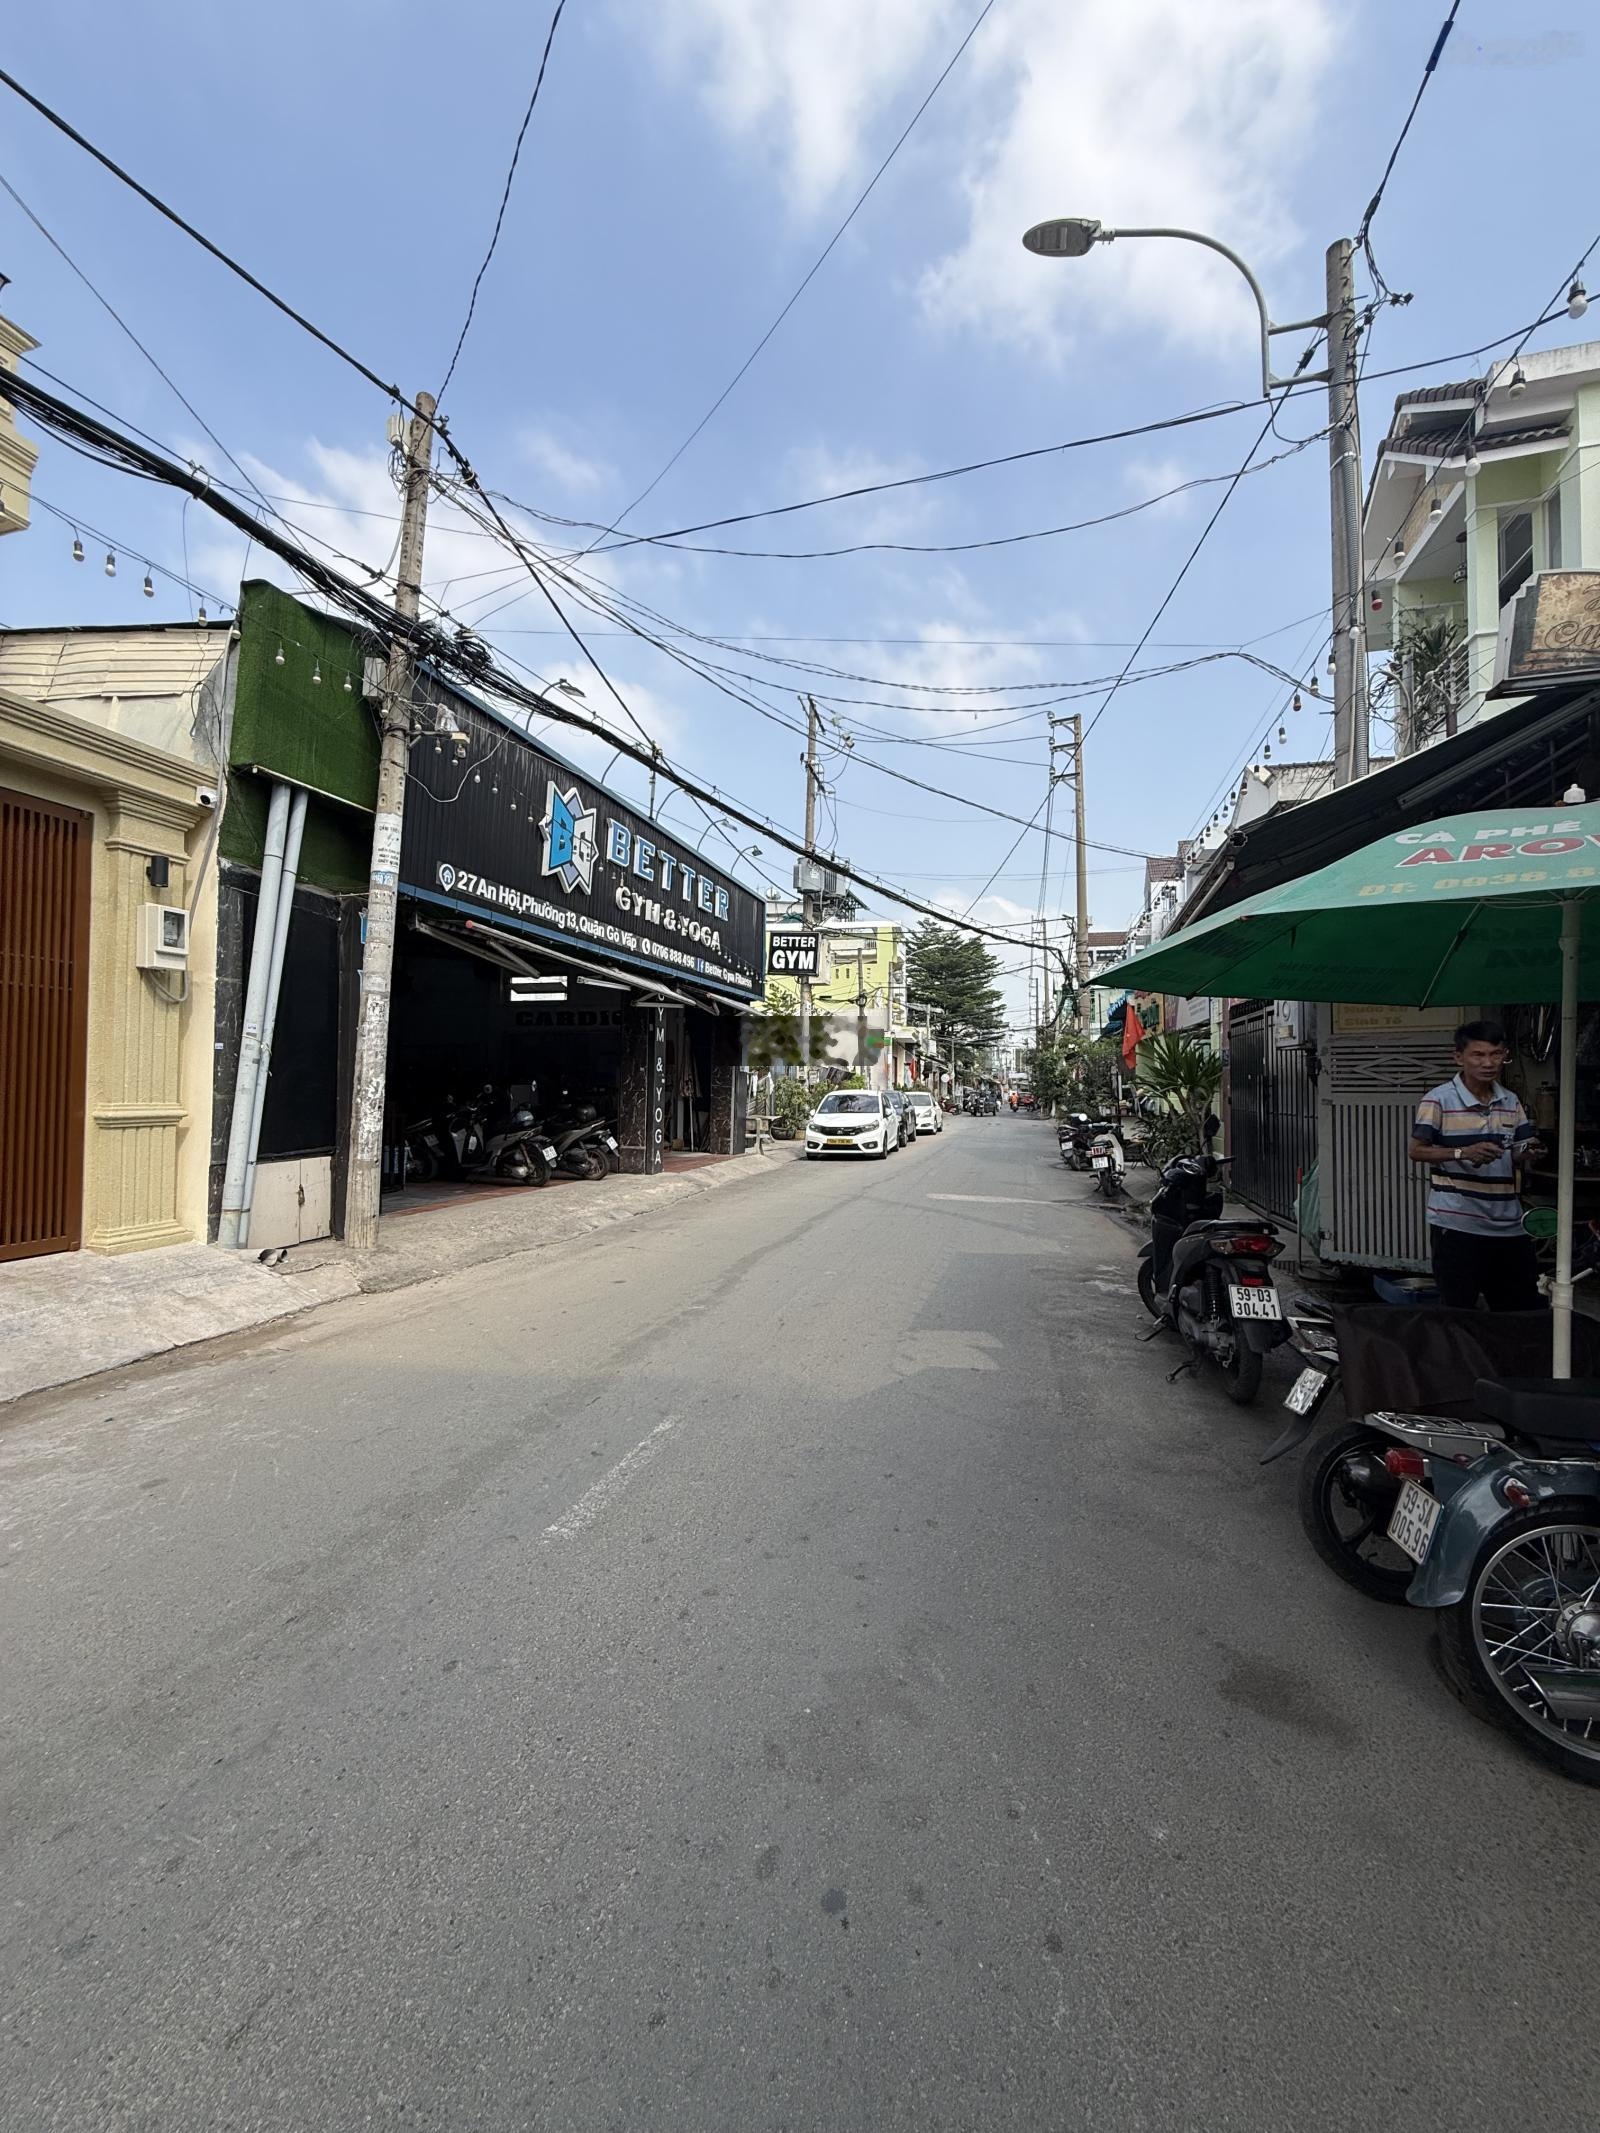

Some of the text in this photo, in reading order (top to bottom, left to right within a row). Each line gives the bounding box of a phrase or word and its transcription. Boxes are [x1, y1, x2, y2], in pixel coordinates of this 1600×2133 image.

[1394, 834, 1600, 868] ARO
[606, 817, 729, 922] BETTER
[457, 870, 478, 893] 27
[476, 878, 497, 901] An
[705, 961, 723, 979] Better
[678, 915, 722, 951] YOGA
[772, 936, 816, 949] BETTER
[772, 949, 815, 970] GYM
[654, 1086, 663, 1165] YOGA
[1235, 1302, 1277, 1318] 304.41
[1236, 1287, 1272, 1302] 59-D3
[1403, 1485, 1435, 1529] 59-SA
[1391, 1510, 1429, 1559] 005.96
